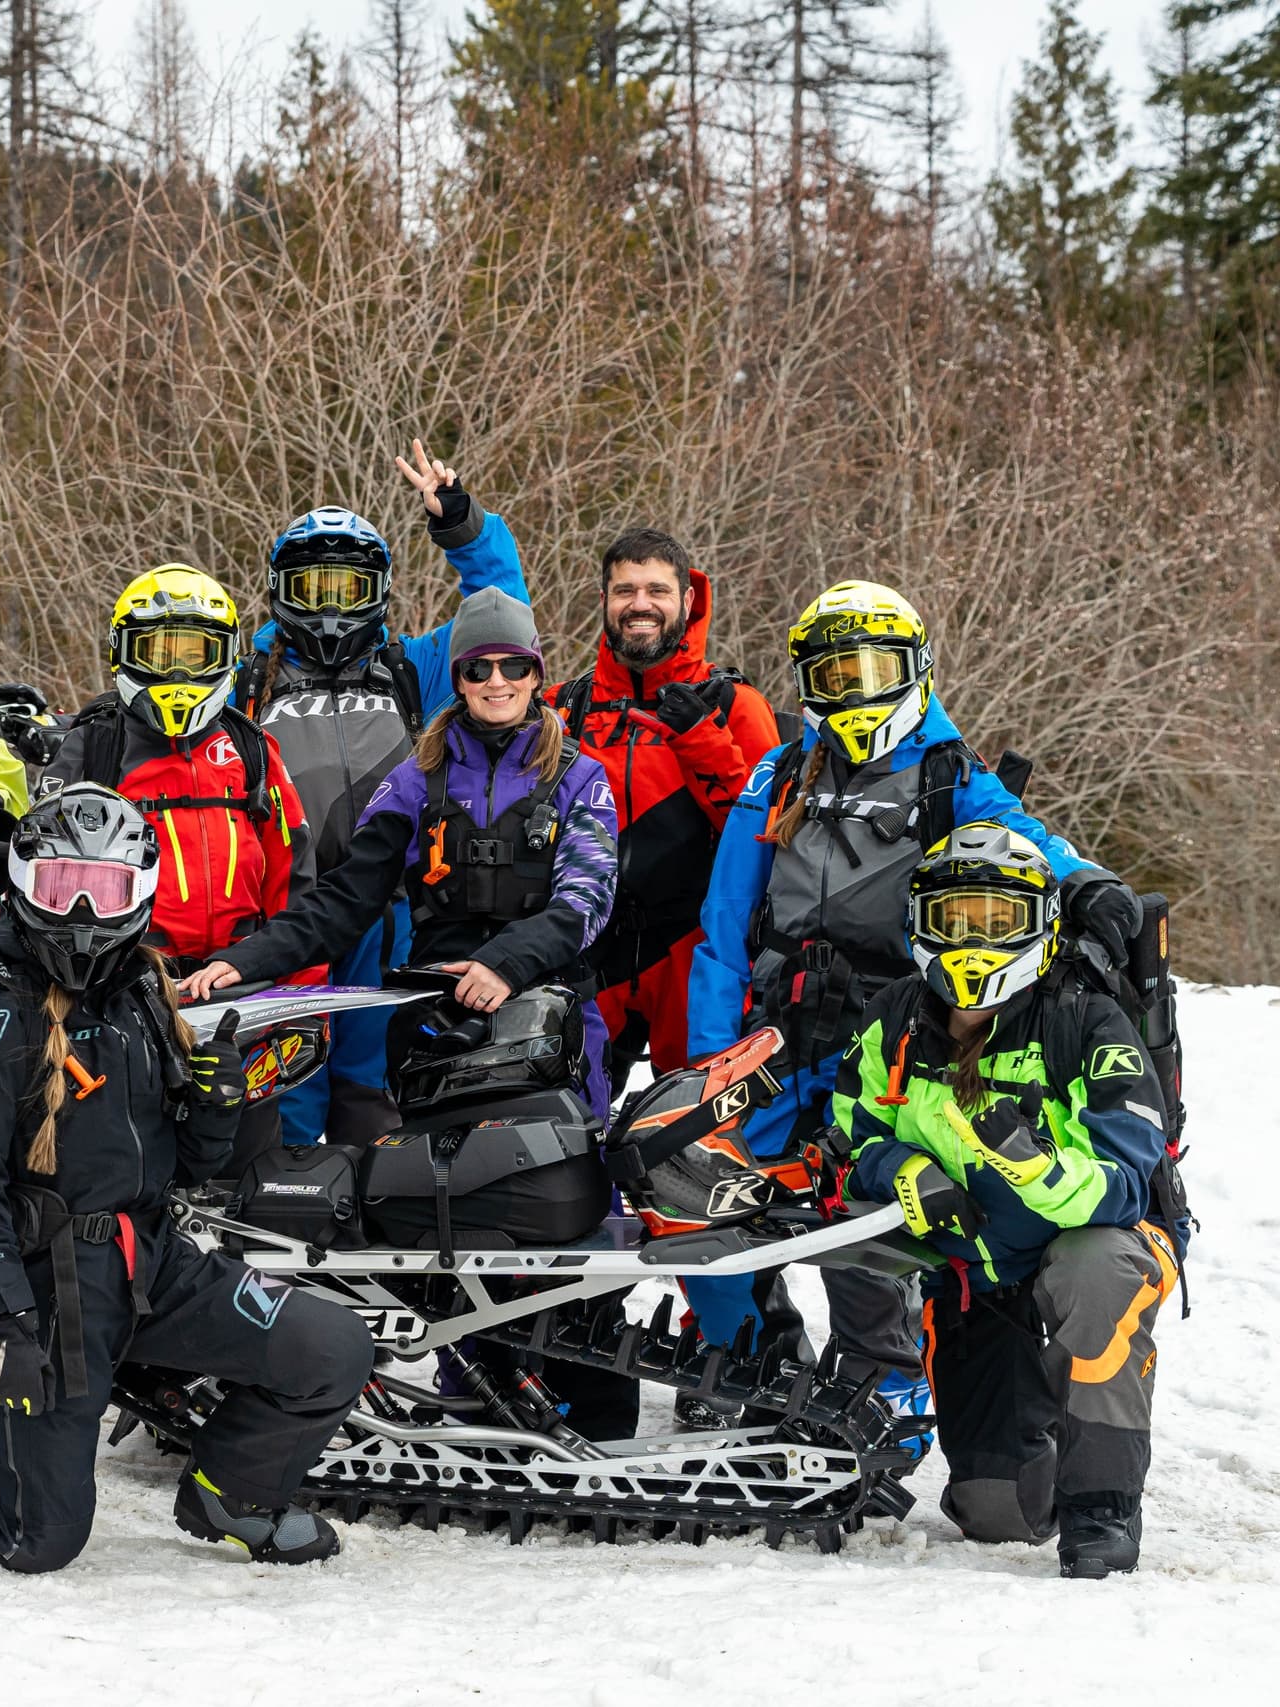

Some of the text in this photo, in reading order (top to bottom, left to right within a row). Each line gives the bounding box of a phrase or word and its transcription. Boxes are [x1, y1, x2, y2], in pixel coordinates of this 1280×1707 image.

[531, 1036, 561, 1058] K
[1093, 1047, 1141, 1077] K
[717, 1083, 746, 1120] K
[711, 1180, 766, 1214] K
